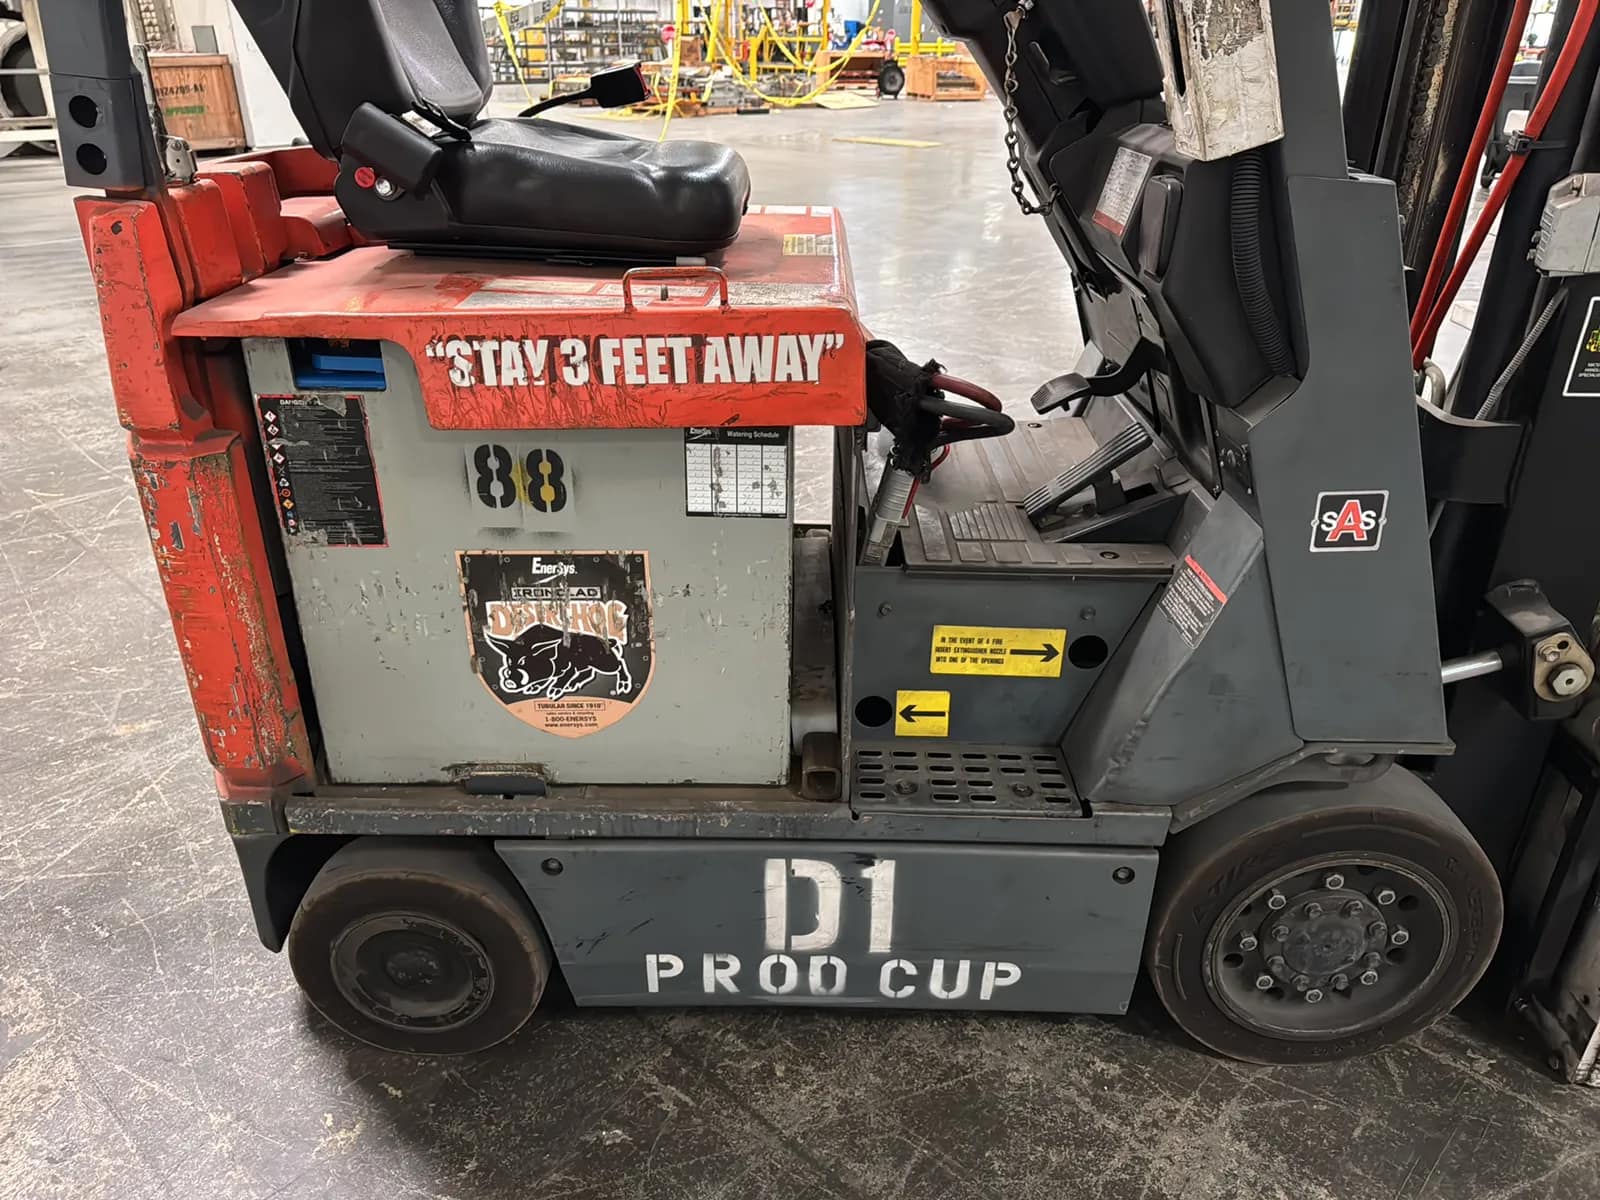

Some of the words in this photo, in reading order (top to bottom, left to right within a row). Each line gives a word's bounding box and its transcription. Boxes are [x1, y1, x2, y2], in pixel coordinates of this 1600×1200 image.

[560, 338, 590, 386] 3
[599, 337, 693, 385] FEET
[703, 333, 845, 385] AWAY”
[727, 431, 752, 439] Watering
[473, 443, 567, 513] 88
[1320, 499, 1377, 542] SAS
[531, 556, 576, 575] EnerSys
[764, 858, 896, 953] D1
[645, 953, 848, 996] PROD
[878, 958, 1023, 1001] CUP
